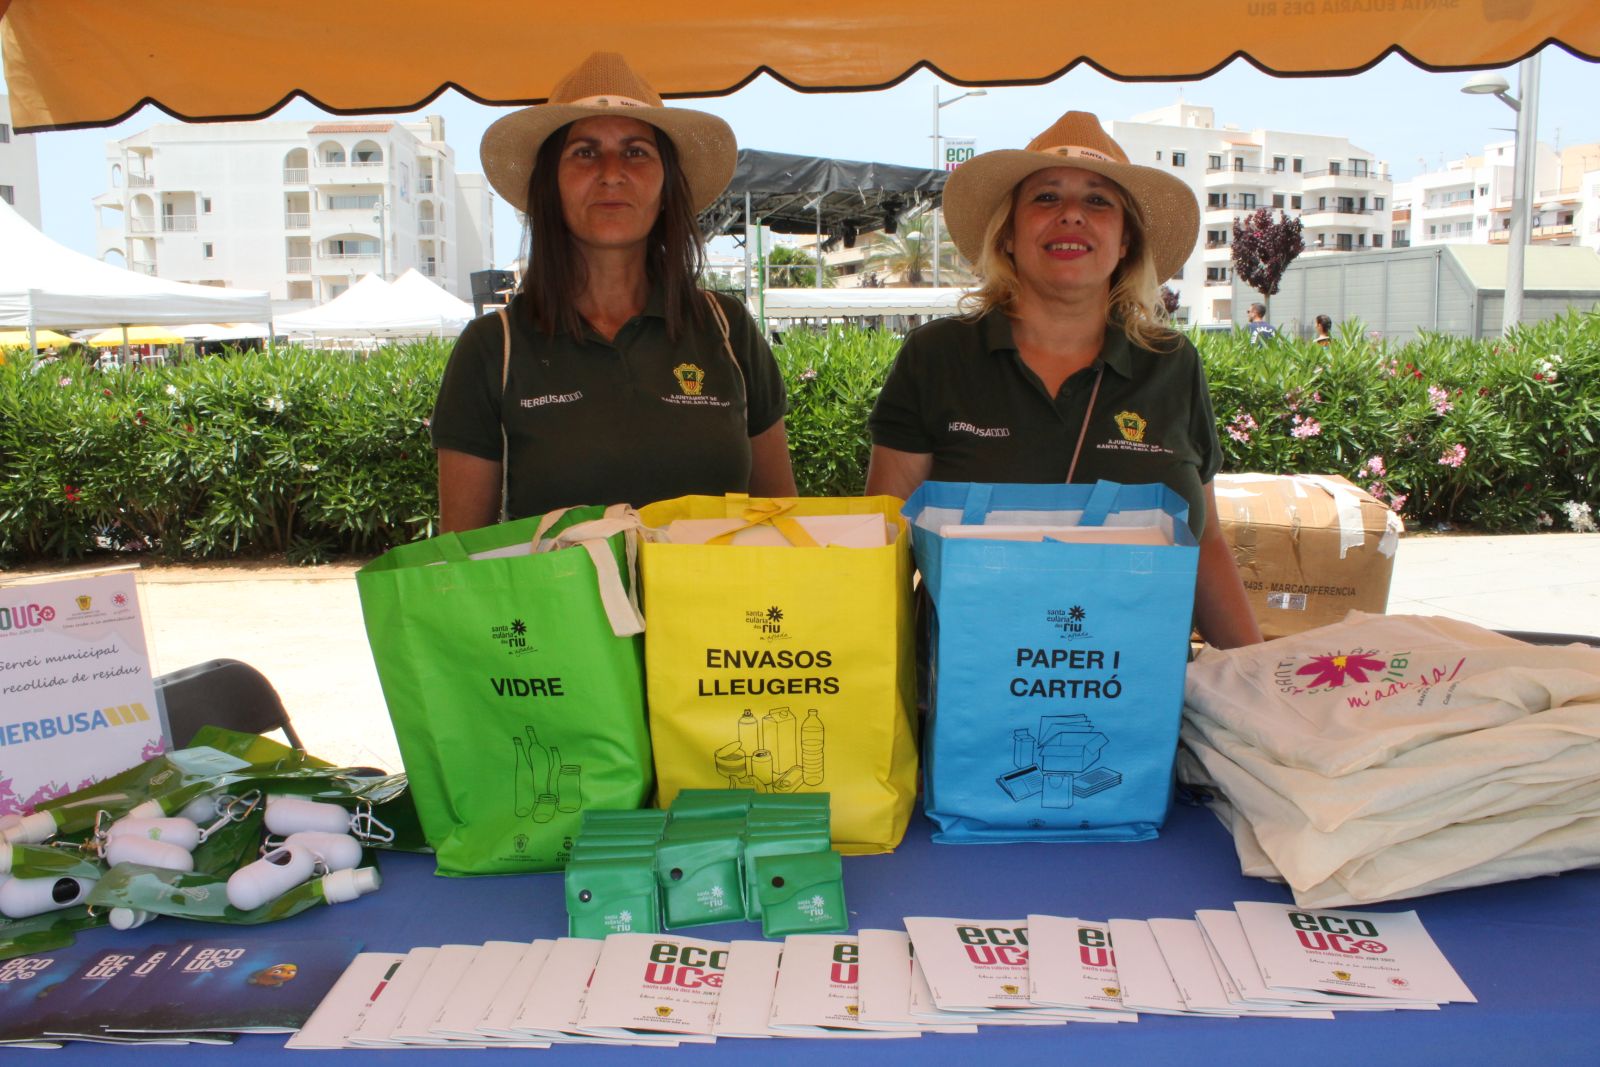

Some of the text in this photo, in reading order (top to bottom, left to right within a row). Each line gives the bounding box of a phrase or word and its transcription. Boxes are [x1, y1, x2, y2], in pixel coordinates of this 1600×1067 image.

[520, 394, 566, 408] HERBUSA
[948, 421, 992, 437] HERBUSA
[1270, 583, 1356, 597] MARCADIFERENCIA
[762, 622, 780, 633] riu
[1063, 621, 1082, 632] riu
[509, 635, 526, 647] riu
[45, 643, 119, 664] municipal
[706, 648, 832, 669] ENVASOS
[1016, 648, 1120, 669] PAPER I
[3, 664, 141, 695] recollida de residus
[490, 677, 565, 697] VIDRE
[698, 676, 840, 697] LLEUGERS
[1009, 674, 1122, 699] CARTRÓ
[1288, 912, 1379, 937] eco
[195, 948, 246, 960] eco
